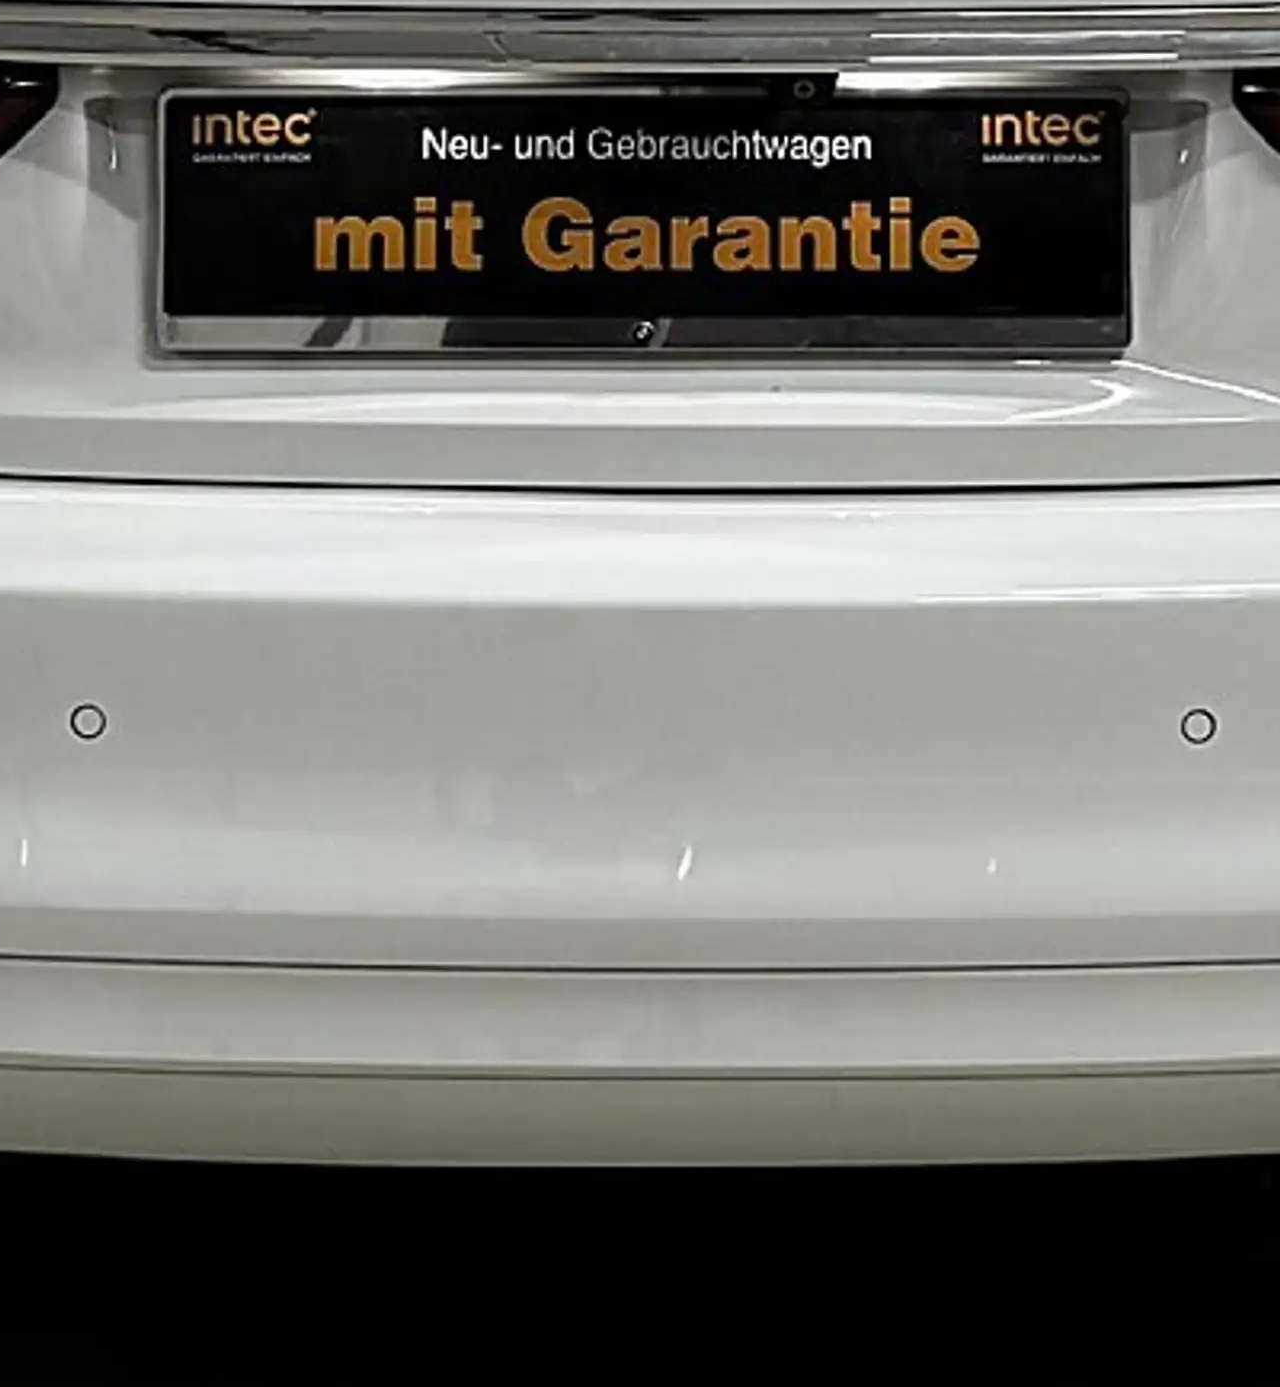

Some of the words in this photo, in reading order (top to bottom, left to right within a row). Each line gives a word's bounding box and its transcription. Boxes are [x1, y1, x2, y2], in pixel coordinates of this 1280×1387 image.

[192, 109, 312, 146] intec
[982, 110, 1100, 146] intec
[422, 127, 503, 160] Neu-
[514, 128, 575, 160] und
[587, 127, 872, 169] Gebrauchtwagen
[315, 196, 483, 271] mit
[522, 196, 980, 272] Garantie
